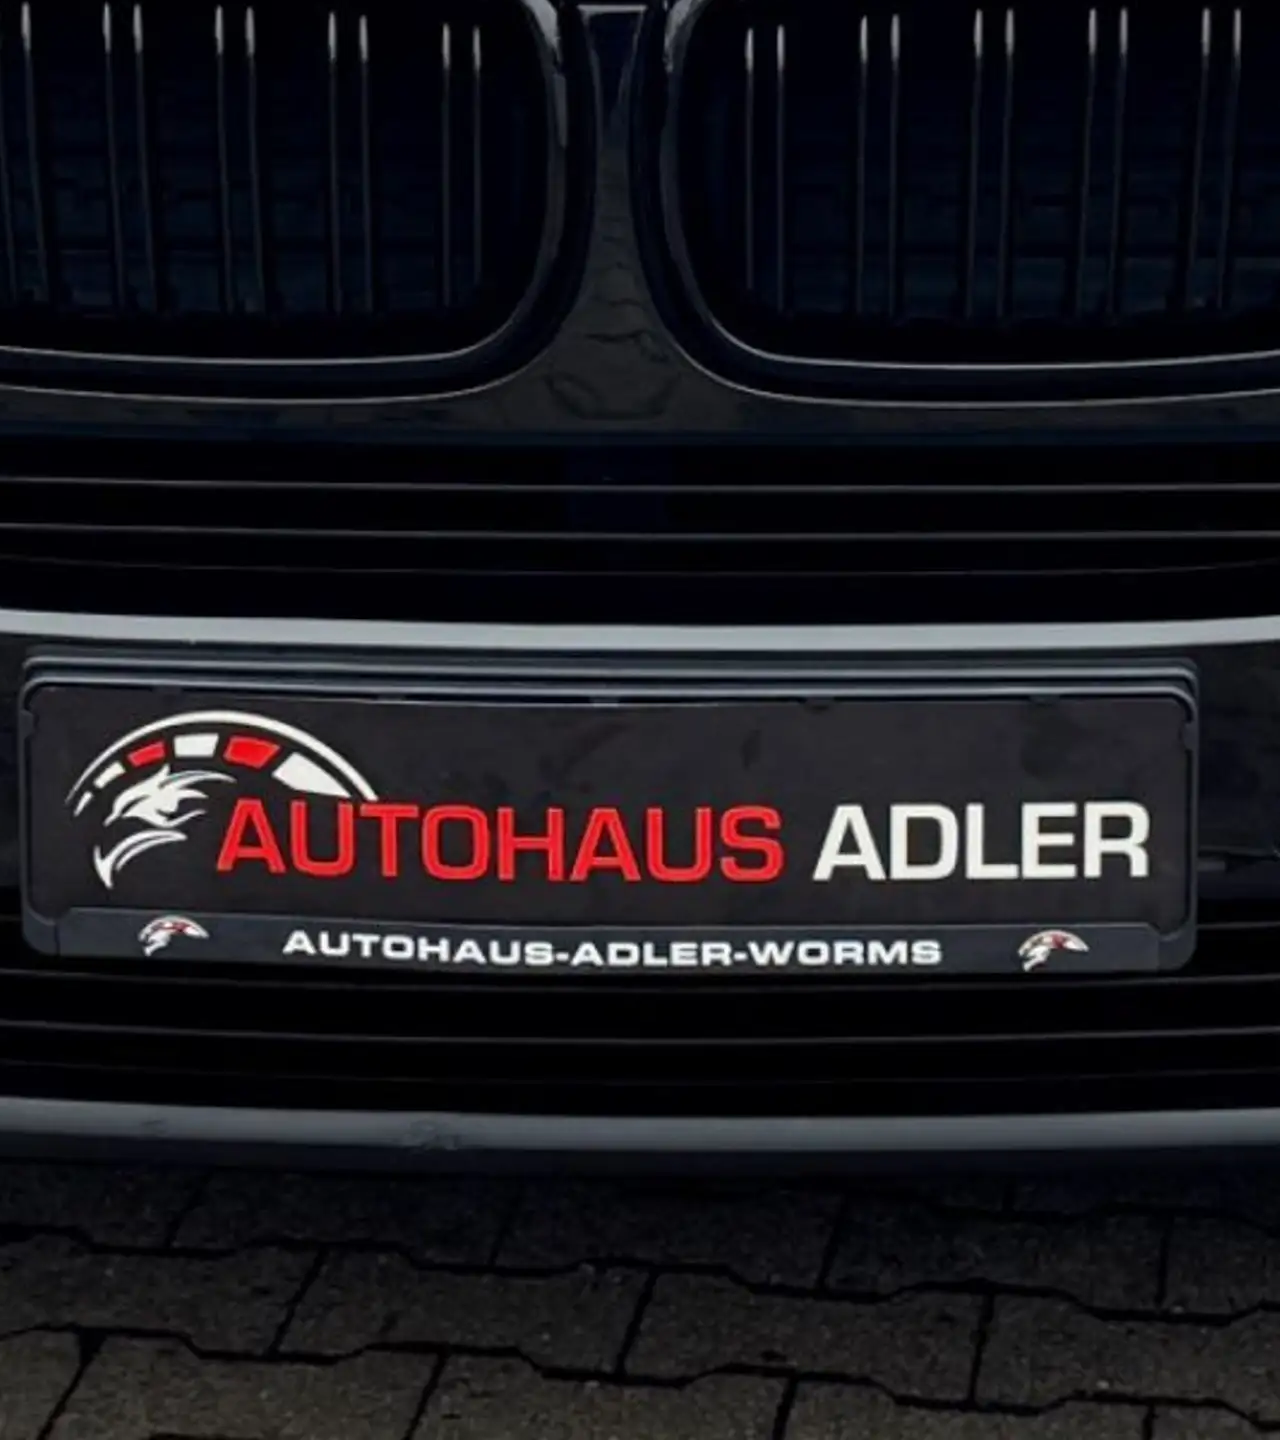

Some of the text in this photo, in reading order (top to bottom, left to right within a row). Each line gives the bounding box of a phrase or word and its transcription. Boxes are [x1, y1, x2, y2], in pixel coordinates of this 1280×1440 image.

[215, 798, 1151, 882] AUTOHAUS ADLER
[282, 929, 943, 968] AUTOHAUS-ADLER-WORMS
